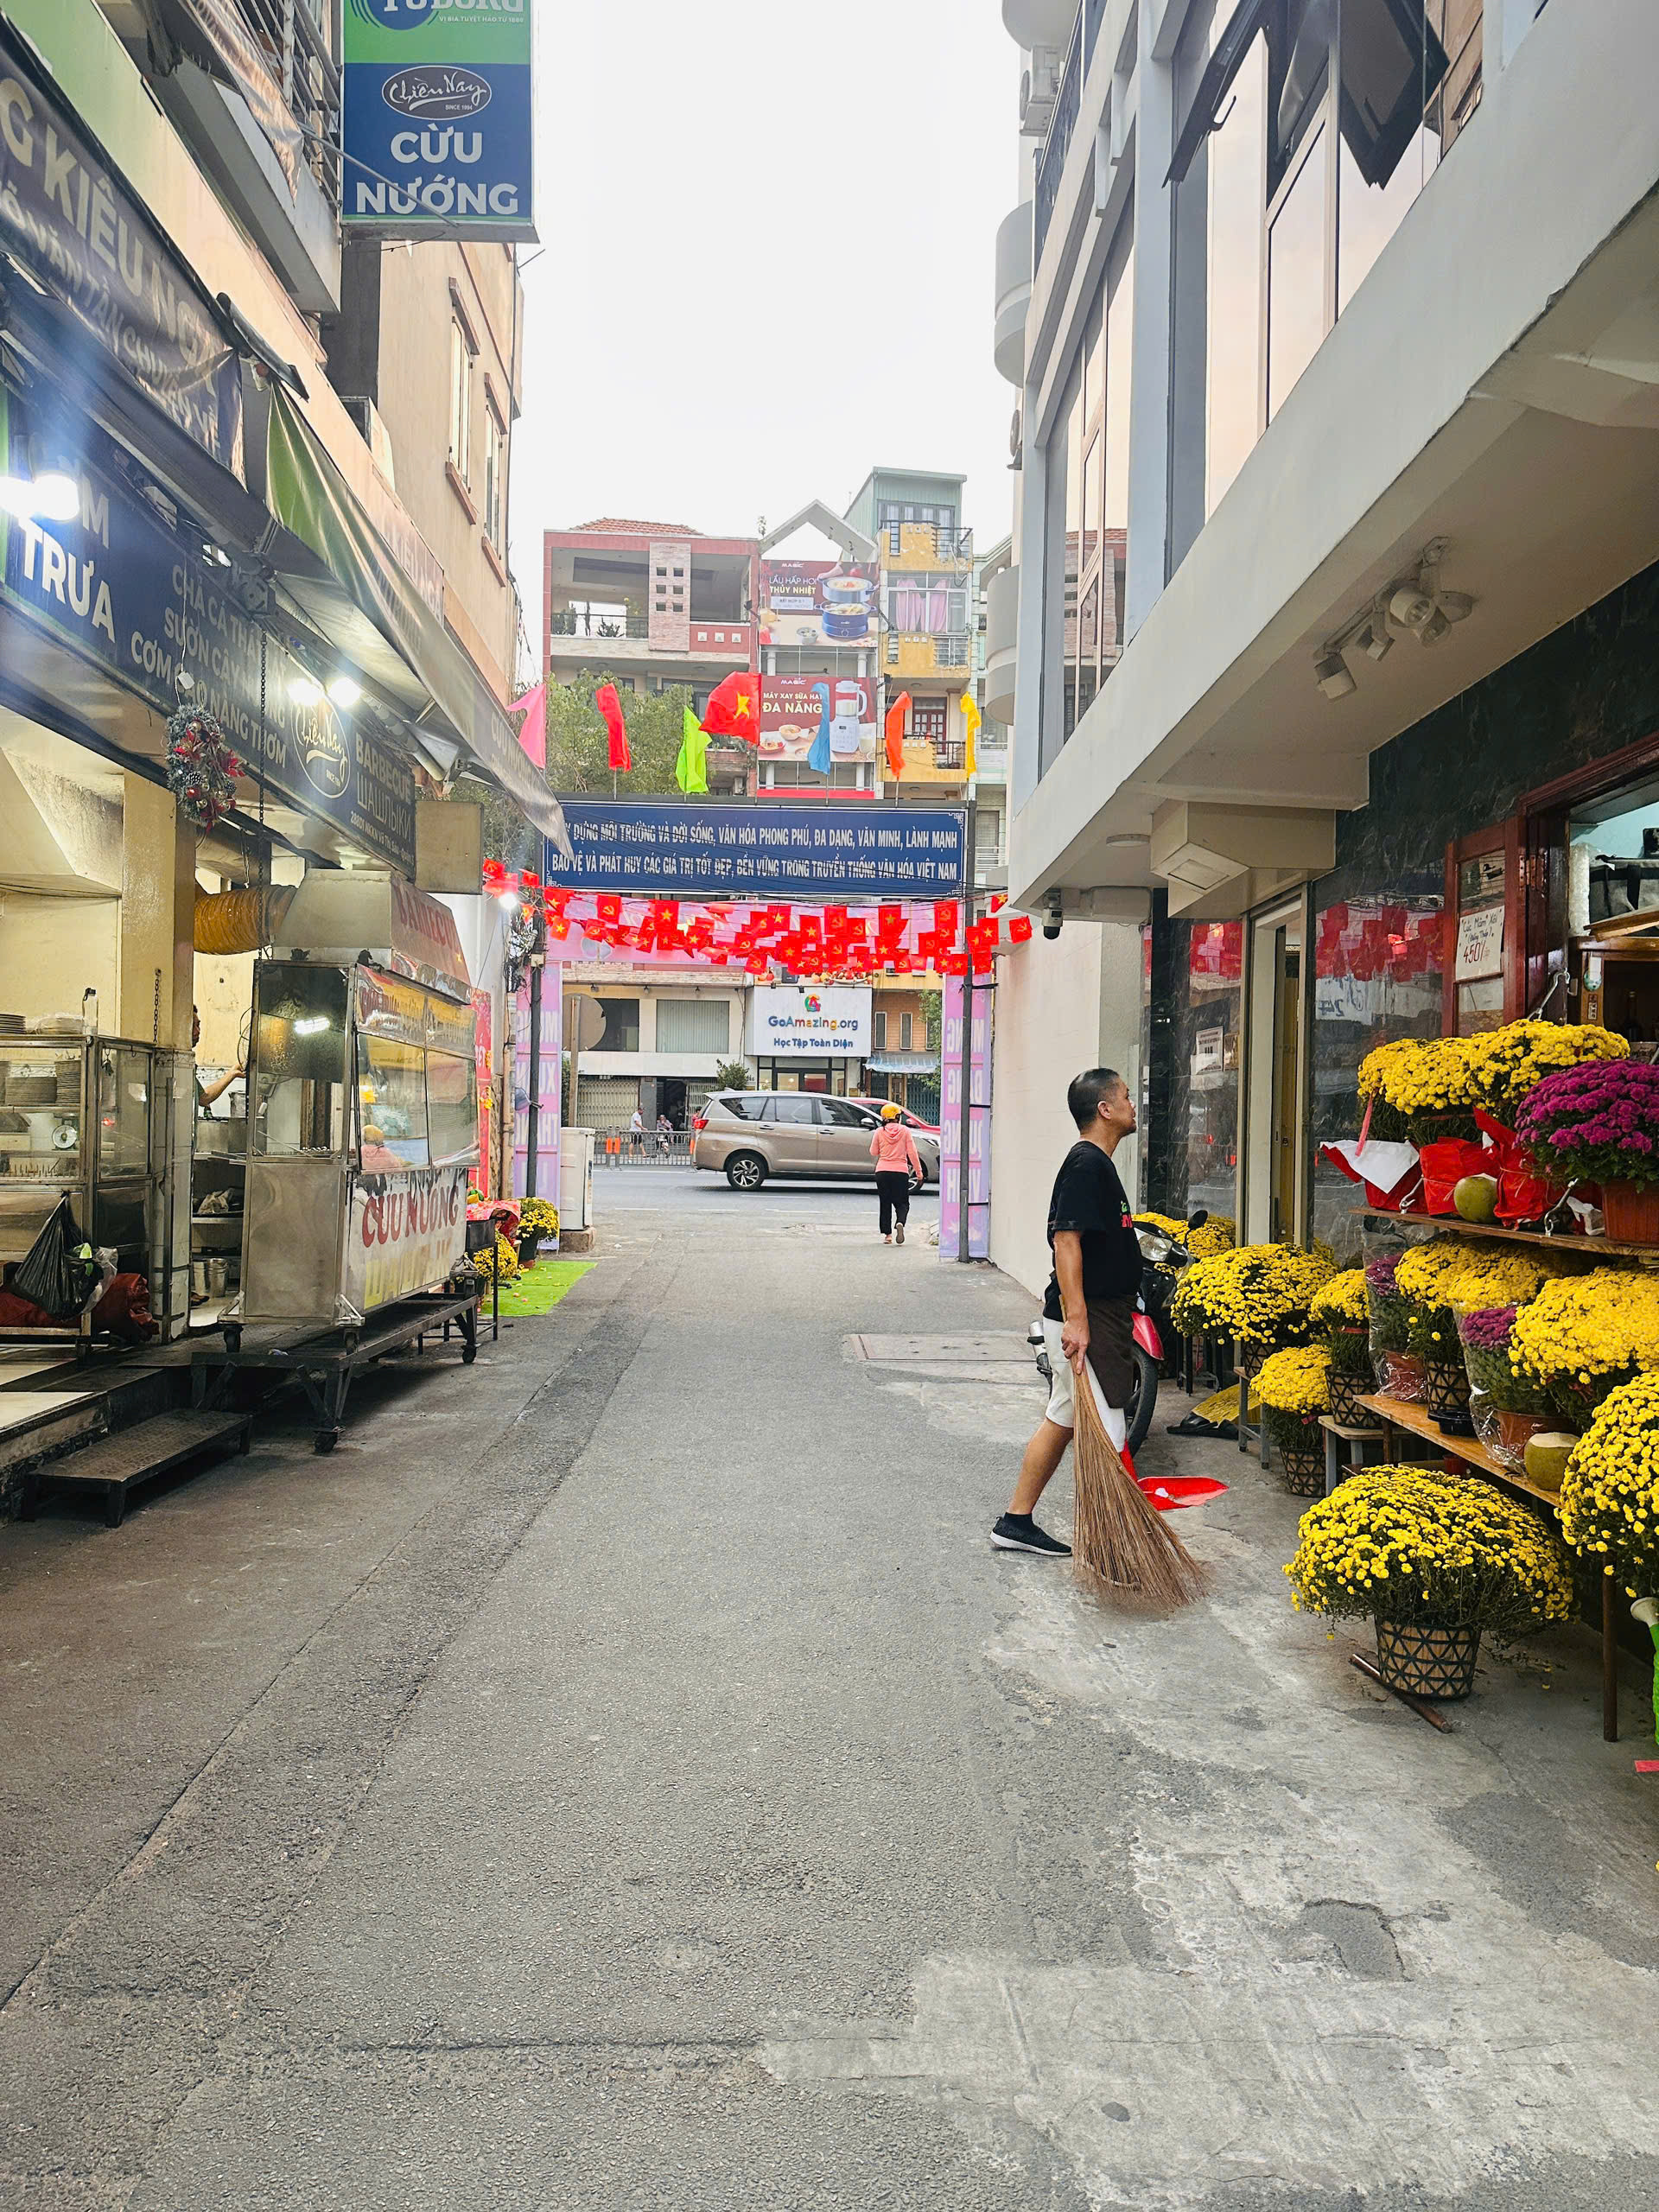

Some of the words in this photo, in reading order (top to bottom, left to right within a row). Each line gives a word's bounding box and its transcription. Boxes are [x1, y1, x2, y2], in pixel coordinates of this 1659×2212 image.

[443, 71, 486, 106] Nay
[391, 122, 482, 163] CỪU
[356, 173, 518, 214] NƯỚNG
[17, 517, 115, 643] TRƯA
[793, 585, 817, 596] NHIỆT
[130, 630, 172, 685] CƠM
[762, 702, 781, 713] ĐA
[785, 701, 823, 714] NĂNG
[795, 691, 808, 700] SỮA
[356, 733, 410, 804] BARBECUE
[357, 772, 411, 843] ШАШЛЫКИ
[574, 820, 598, 844] DỰNG
[601, 820, 617, 841] MÔI
[620, 819, 656, 842] TRƯỜNG
[658, 821, 671, 842] VÀ
[672, 820, 688, 844] ĐỜI
[719, 823, 736, 844] VĂN
[738, 823, 756, 845] HÓA
[759, 827, 789, 846] PHONG
[791, 823, 811, 849] PHÚ,
[814, 829, 827, 847] ĐA
[829, 829, 855, 850] DẠNG,
[858, 826, 875, 848] VĂN
[878, 830, 903, 850] MINH,
[906, 826, 929, 849] LÀNH
[931, 830, 957, 852] MẠNH
[573, 849, 583, 876] VỆ
[585, 850, 597, 872] VÀ
[599, 851, 621, 873] PHÁT
[624, 855, 641, 874] HUY
[644, 852, 660, 874] CÁC
[663, 852, 677, 875] GIÁ
[680, 856, 693, 879] TRỊ
[696, 851, 711, 876] TỐT
[736, 852, 754, 876] BỀN
[756, 855, 779, 877] VỮNG
[781, 859, 810, 878] TRONG
[811, 853, 845, 878] TRUYỀN
[847, 855, 876, 879] THỐNG
[878, 857, 894, 879] VĂN
[897, 857, 914, 880] HÓA
[917, 857, 936, 882] VIỆT
[938, 862, 957, 880] NAM
[768, 1016, 858, 1031] GoAmazing.org
[773, 1038, 791, 1048] Học
[791, 1038, 808, 1049] Tập
[810, 1038, 830, 1047] Toàn
[833, 1039, 853, 1049] Diện
